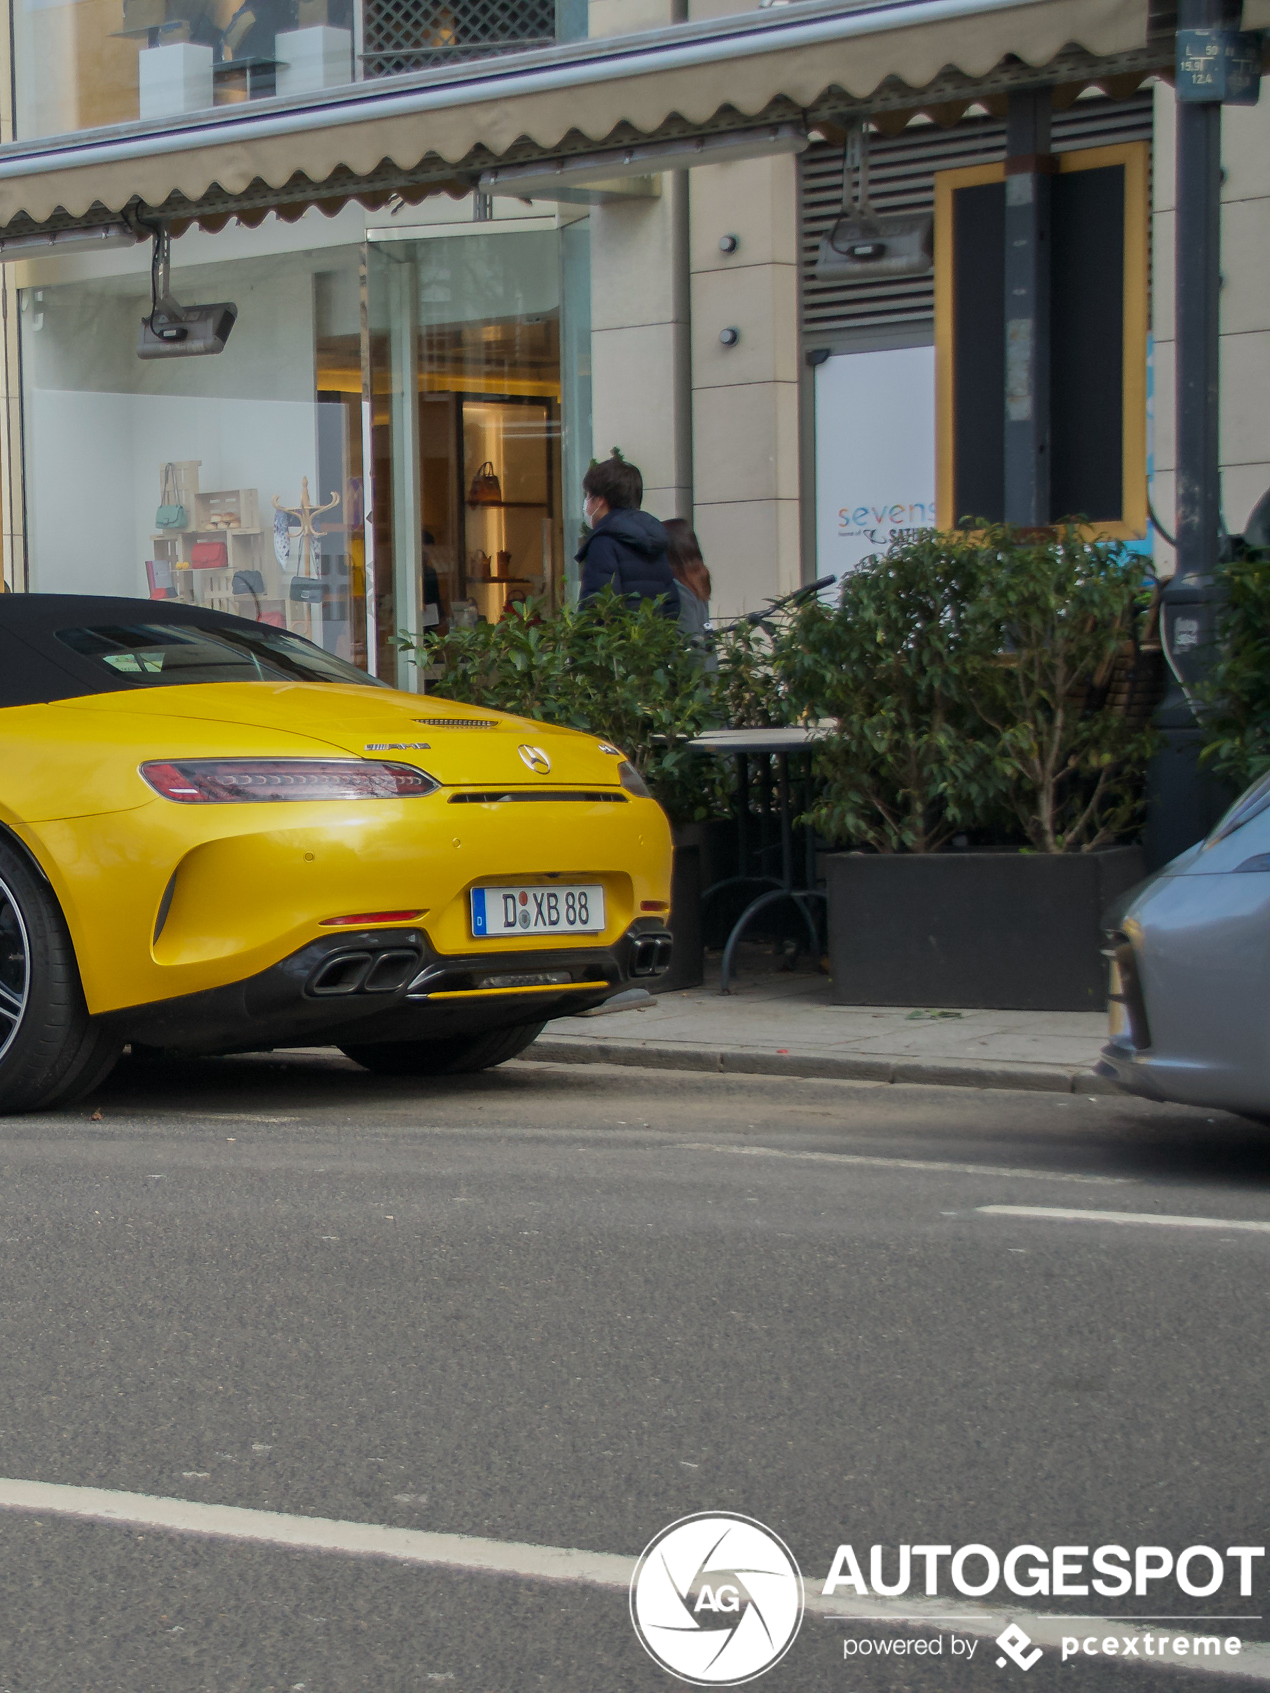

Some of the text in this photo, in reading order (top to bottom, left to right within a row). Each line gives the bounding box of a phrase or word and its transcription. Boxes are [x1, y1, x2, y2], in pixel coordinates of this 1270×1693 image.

[502, 891, 589, 928] D XB 88
